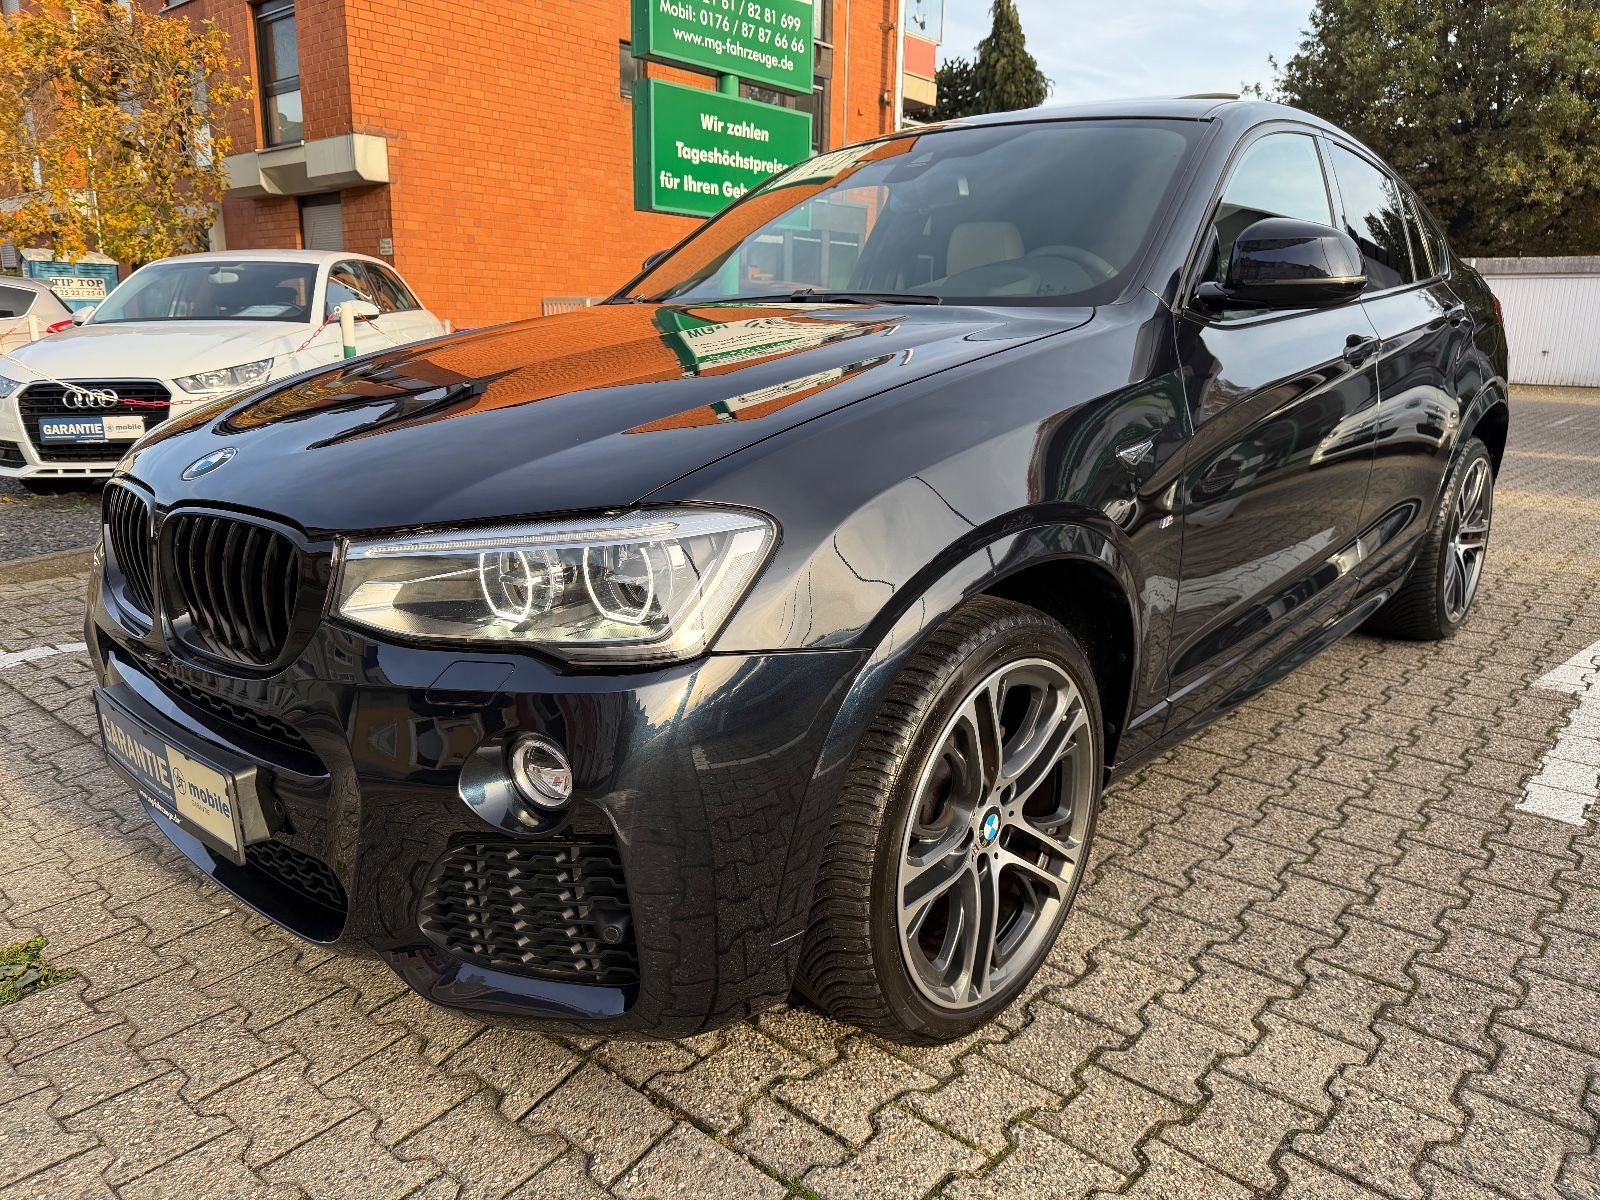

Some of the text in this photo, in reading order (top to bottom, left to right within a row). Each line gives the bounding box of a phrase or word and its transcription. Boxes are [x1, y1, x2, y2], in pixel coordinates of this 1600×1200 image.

[660, 0, 805, 54] Mobil: 0176 / 87 87 66 66
[747, 3, 761, 20] 82
[764, 8, 776, 25] 81
[780, 13, 801, 32] 699
[672, 27, 794, 71] www.mg-fahrzeuge.de
[700, 113, 769, 142] Wir zahlen
[659, 170, 680, 190] für
[684, 174, 719, 196] Ihren
[52, 278, 73, 287] TIP
[78, 279, 103, 288] TOP
[43, 423, 103, 435] GARANTIE
[101, 713, 172, 790] GARANTIE
[188, 781, 230, 819] mobile
